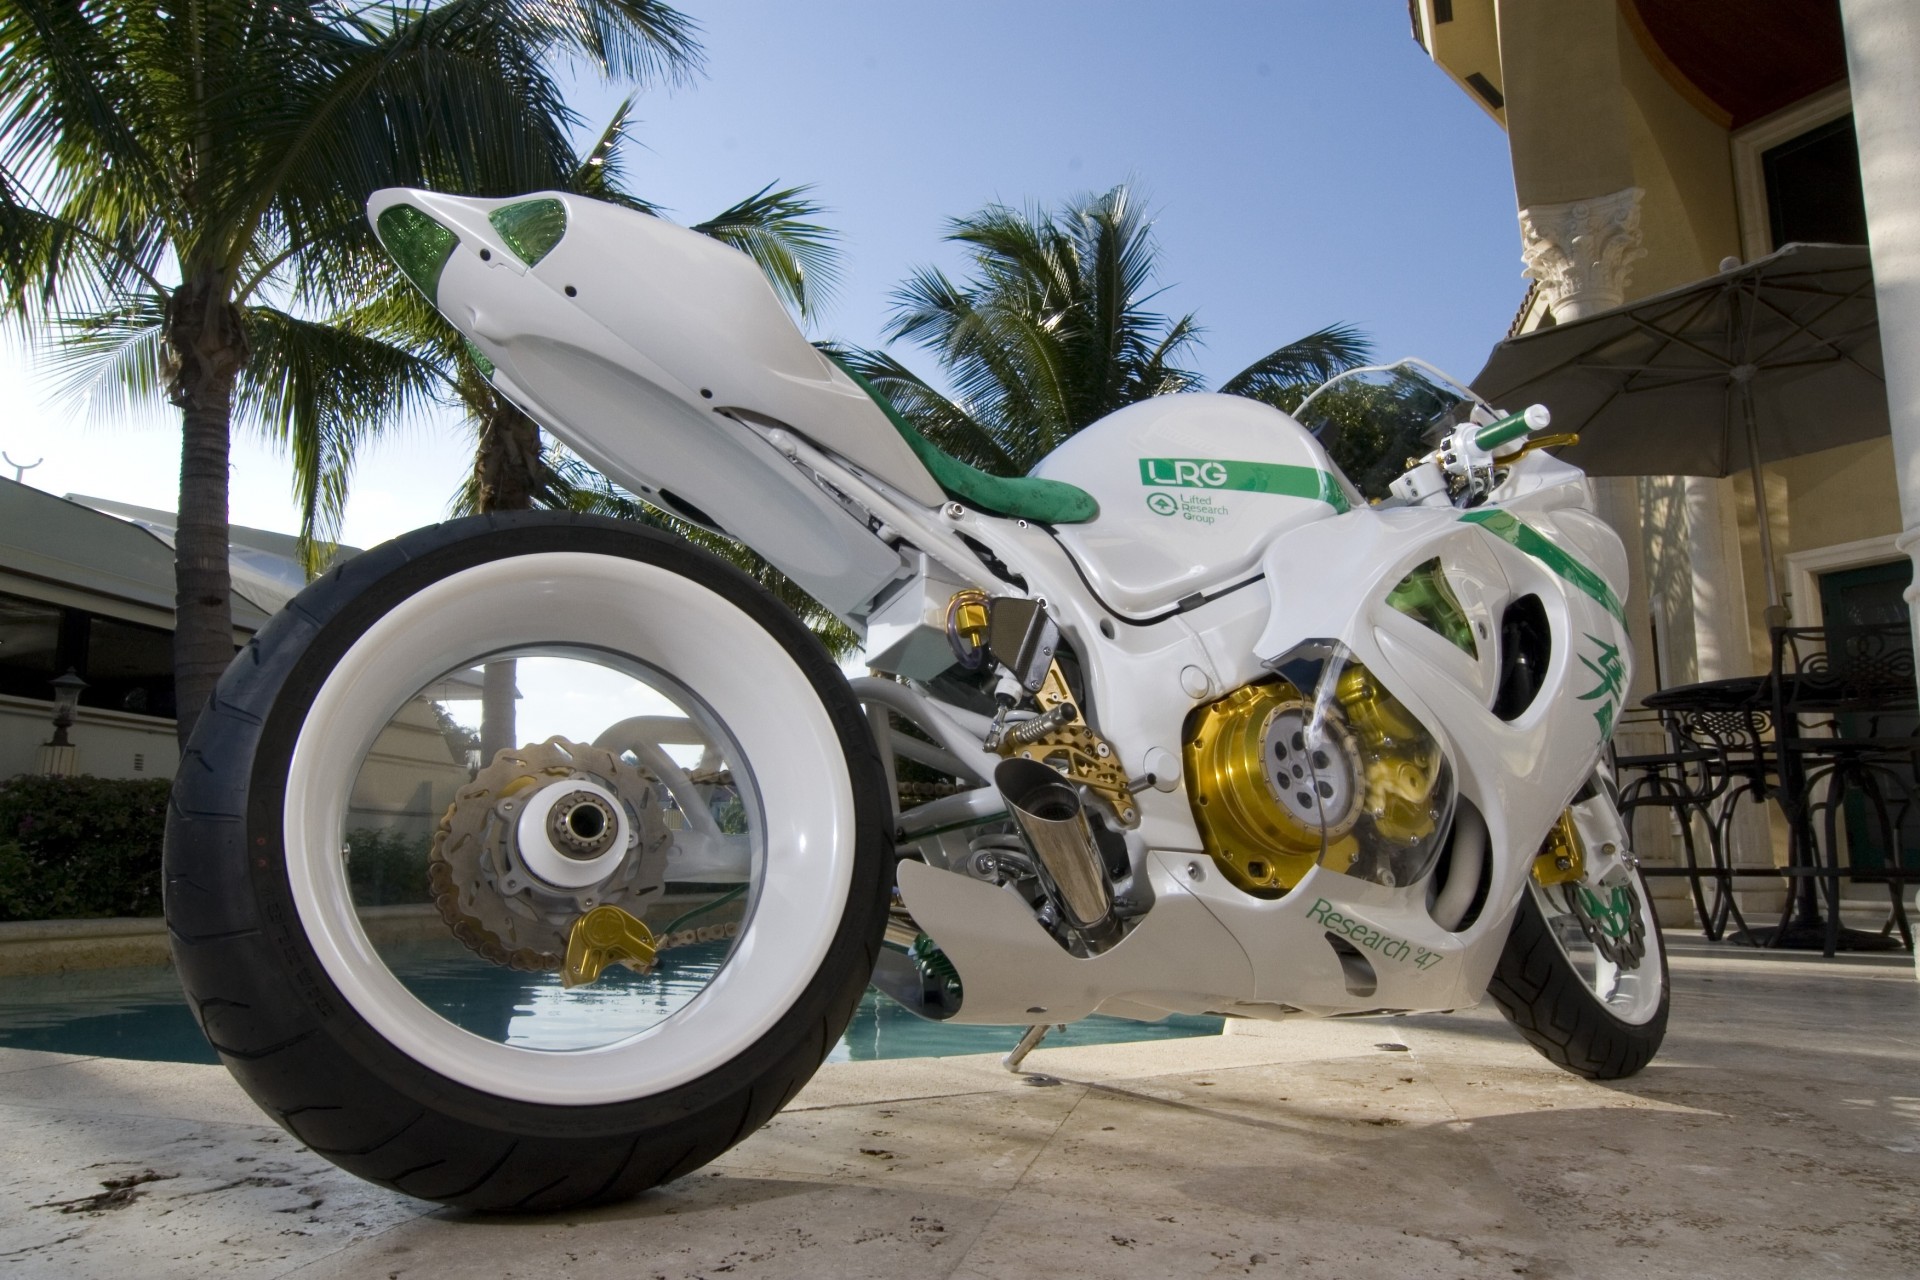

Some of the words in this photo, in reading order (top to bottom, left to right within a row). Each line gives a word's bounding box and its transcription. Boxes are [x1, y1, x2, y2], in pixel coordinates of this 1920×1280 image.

[1148, 461, 1228, 487] LRG
[1180, 493, 1211, 504] Lifted
[1182, 503, 1229, 515] Research
[1183, 512, 1214, 525] Group
[1305, 898, 1411, 962] Research
